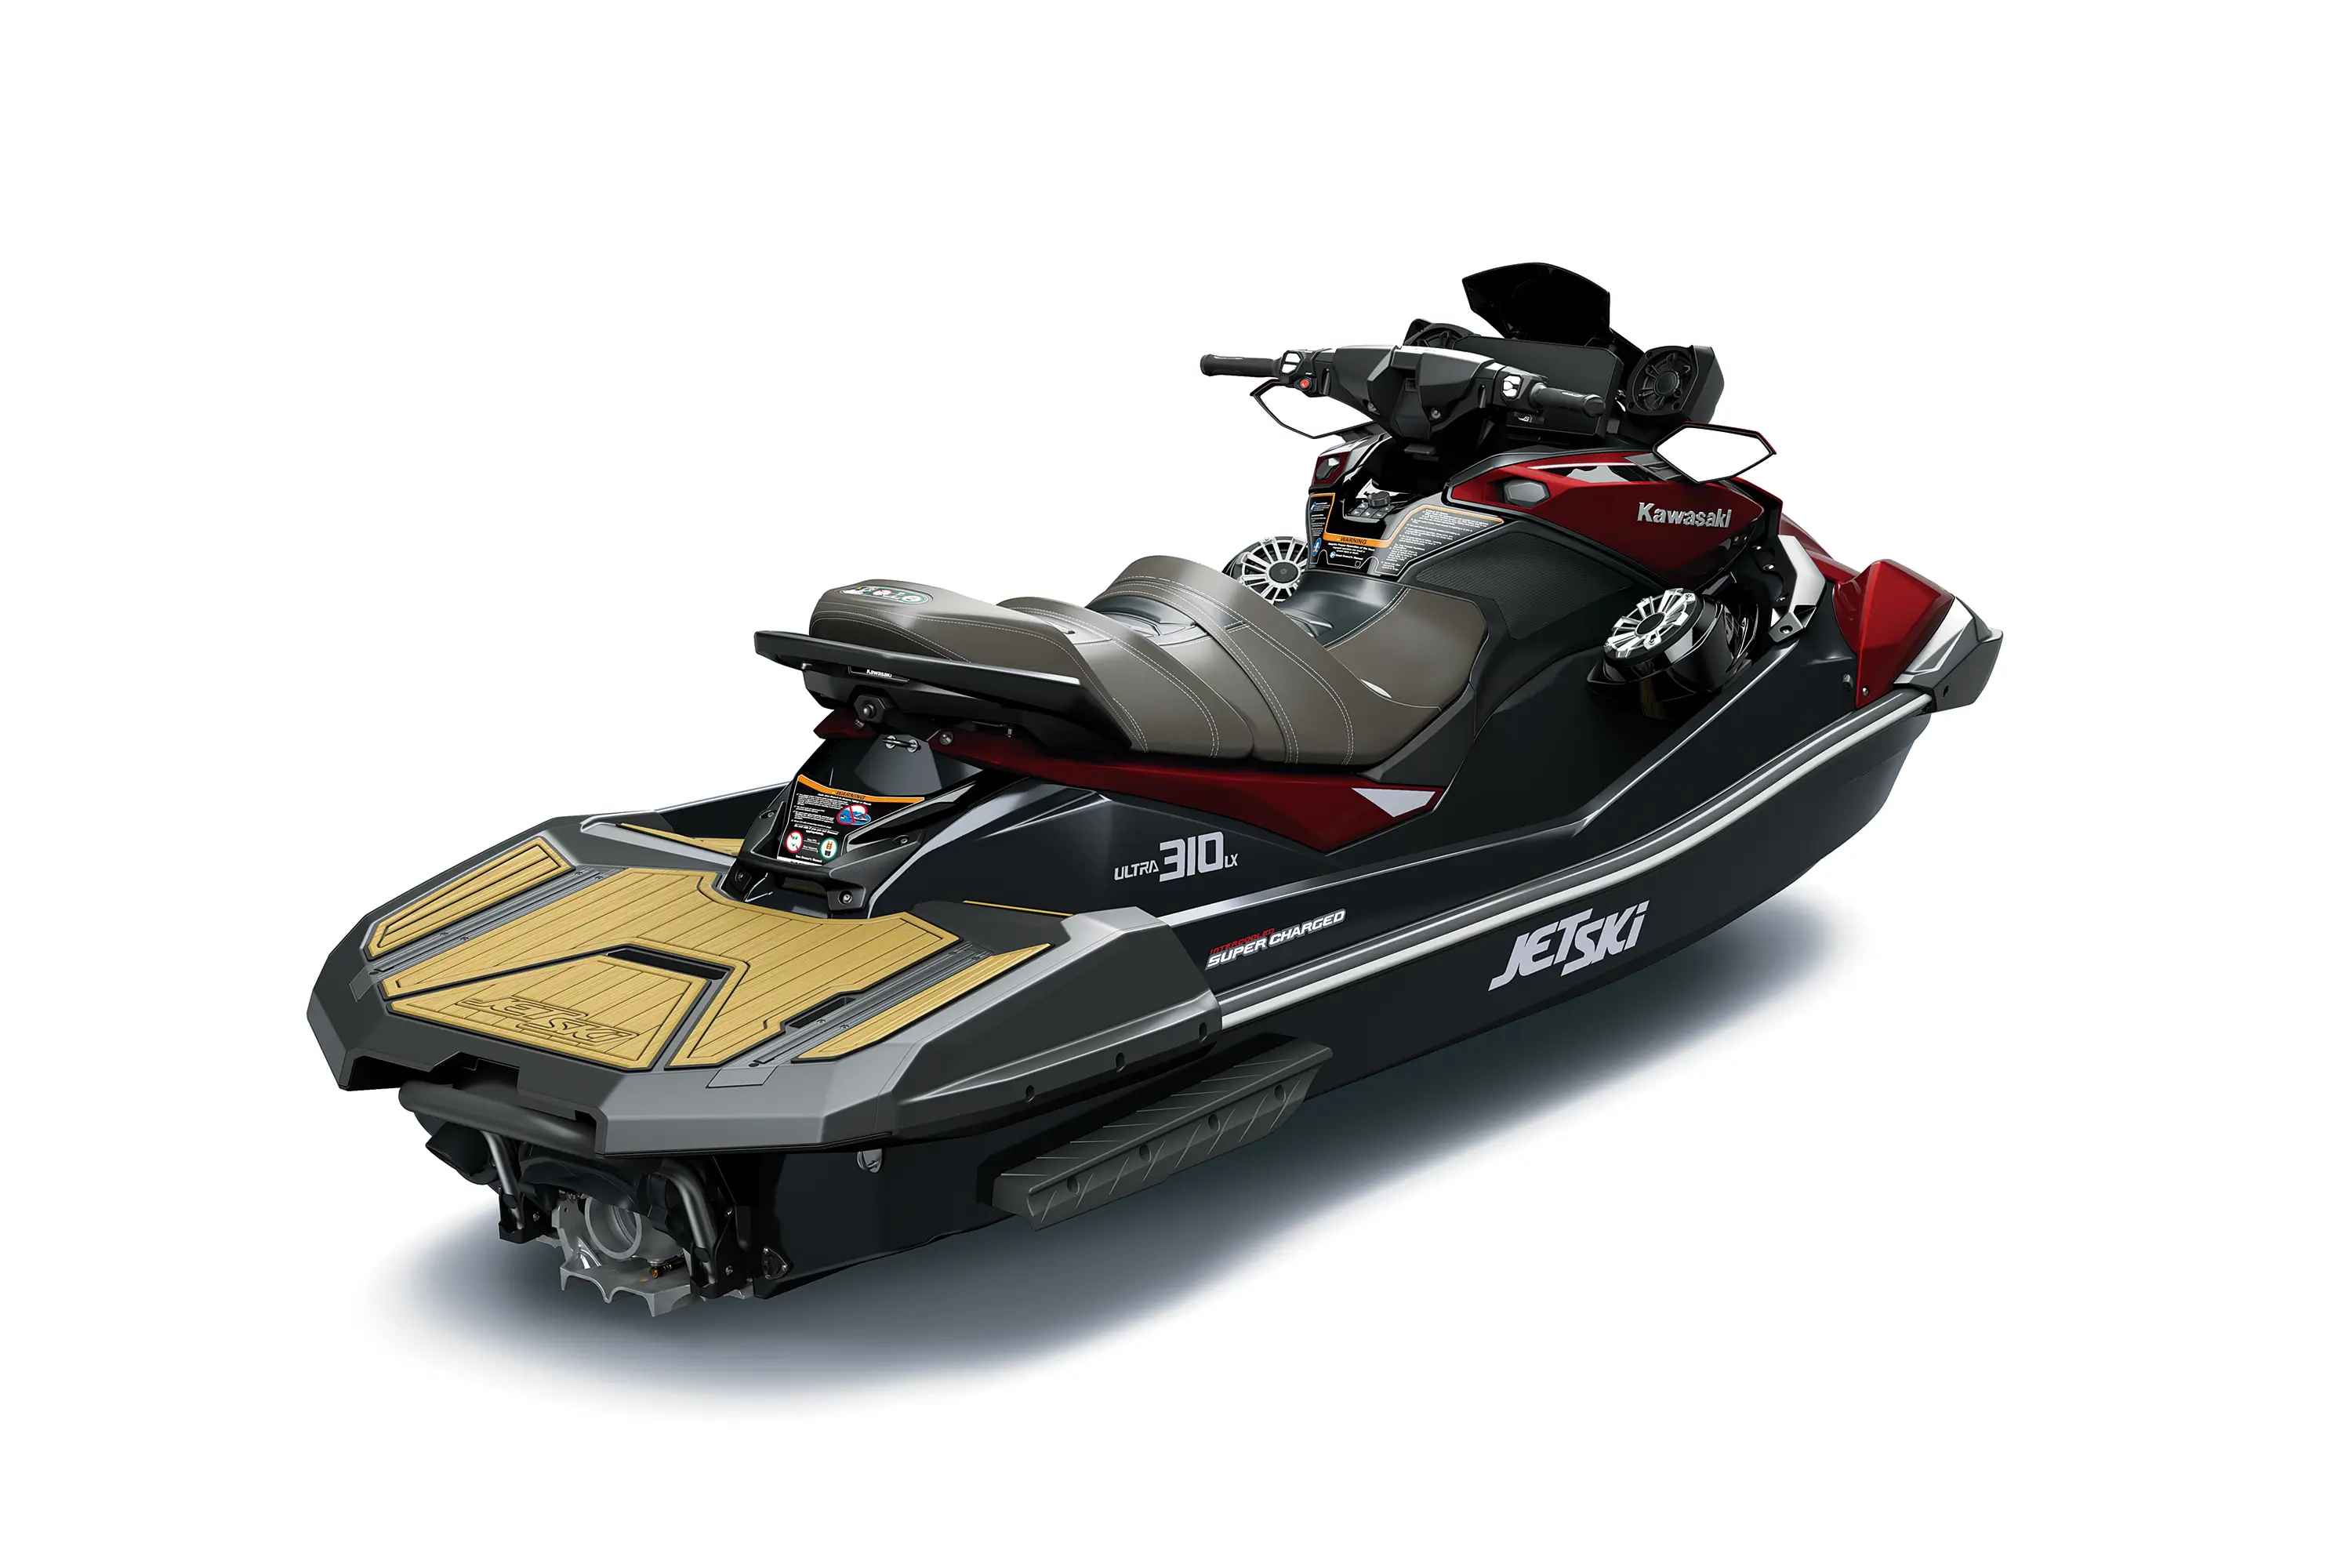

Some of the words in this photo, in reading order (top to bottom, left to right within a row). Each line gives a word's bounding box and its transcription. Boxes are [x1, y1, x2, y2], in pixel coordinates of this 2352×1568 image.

[1637, 502, 1732, 528] Kawasaki
[1340, 536, 1367, 545] WARNING
[866, 669, 892, 678] Kawasaki
[836, 790, 866, 800] WARNING
[1114, 860, 1160, 880] ULTRA
[1160, 831, 1224, 883] 310
[1225, 854, 1239, 869] LX
[1206, 937, 1268, 969] SUPER
[1269, 909, 1347, 946] CHARGED
[1210, 927, 1275, 955] INTERCOOLED
